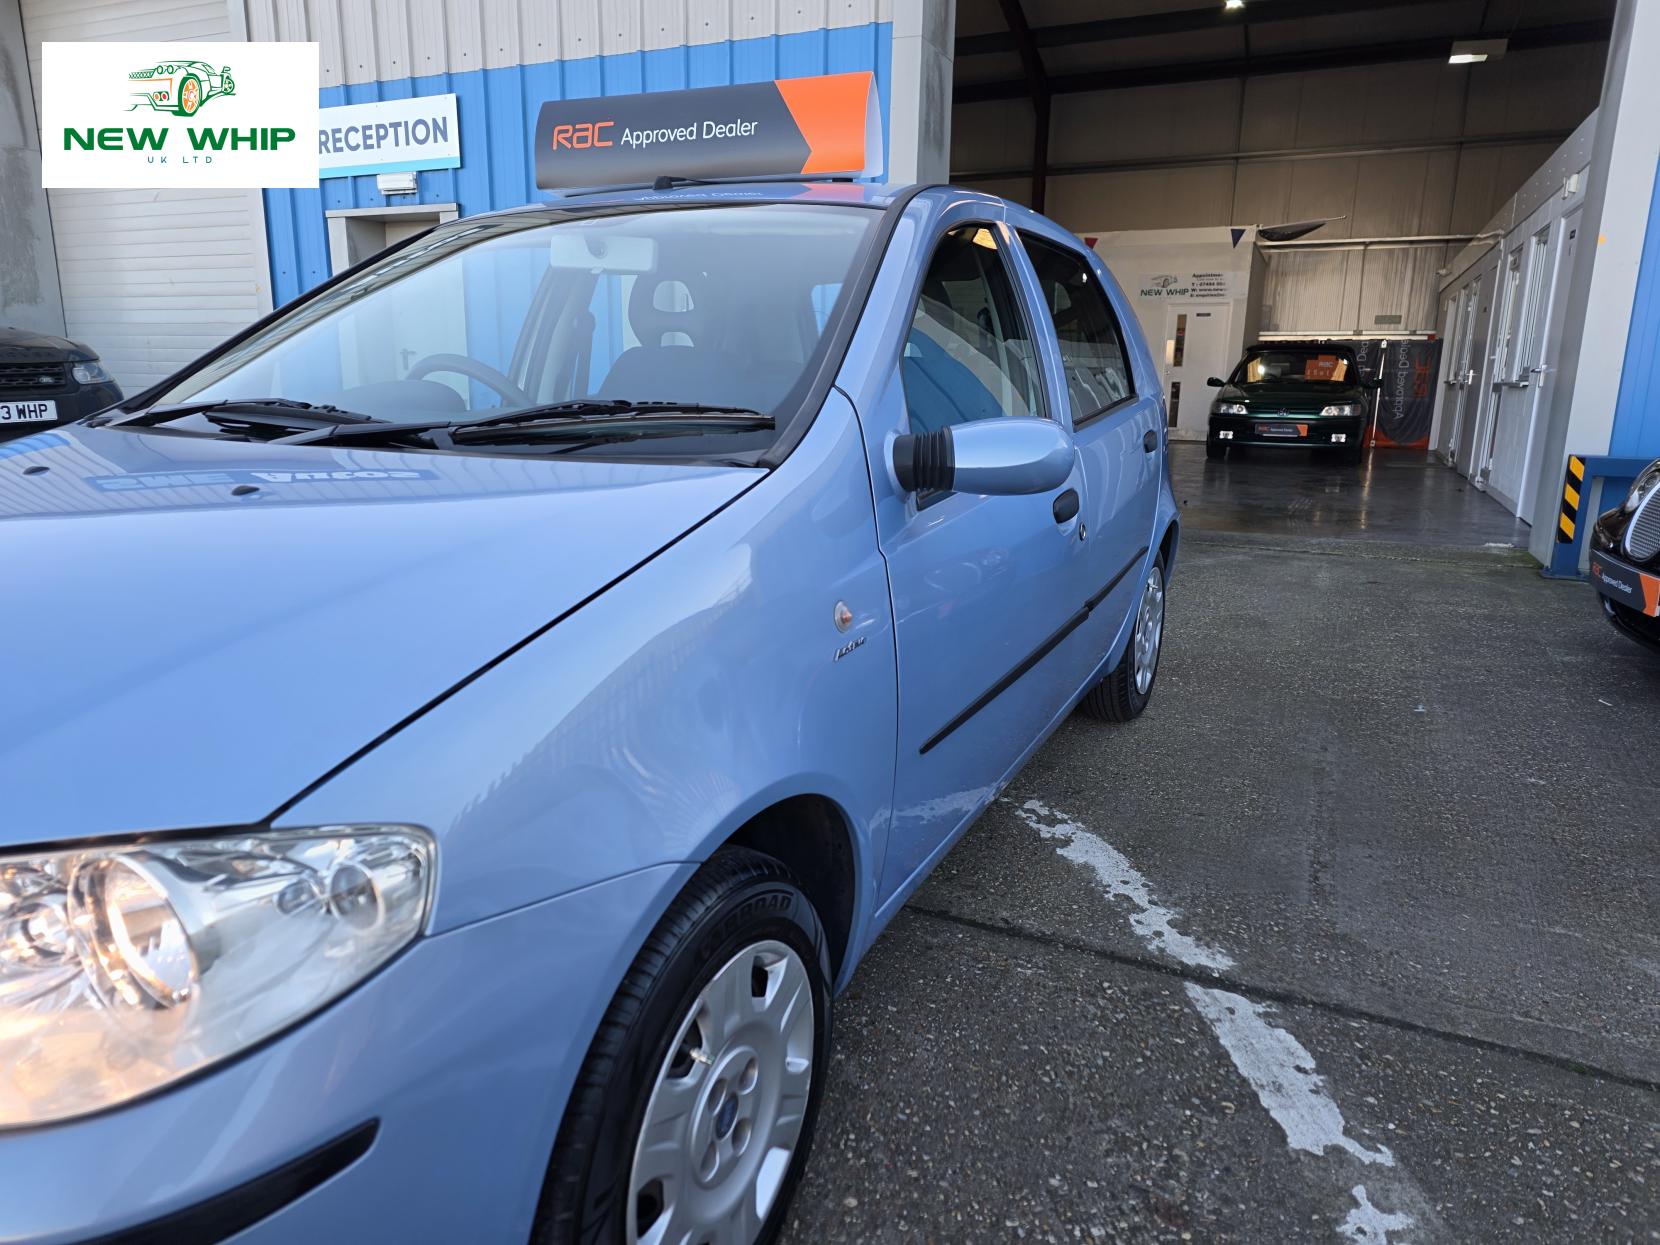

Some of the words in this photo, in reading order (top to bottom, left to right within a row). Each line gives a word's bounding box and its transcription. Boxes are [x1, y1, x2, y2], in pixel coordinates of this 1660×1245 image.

[319, 116, 449, 155] RECEPTION
[620, 121, 698, 150] Approved
[702, 118, 759, 141] Dealer
[1140, 288, 1163, 297] NEW
[1166, 287, 1190, 296] WHIP
[16, 403, 48, 420] WHP
